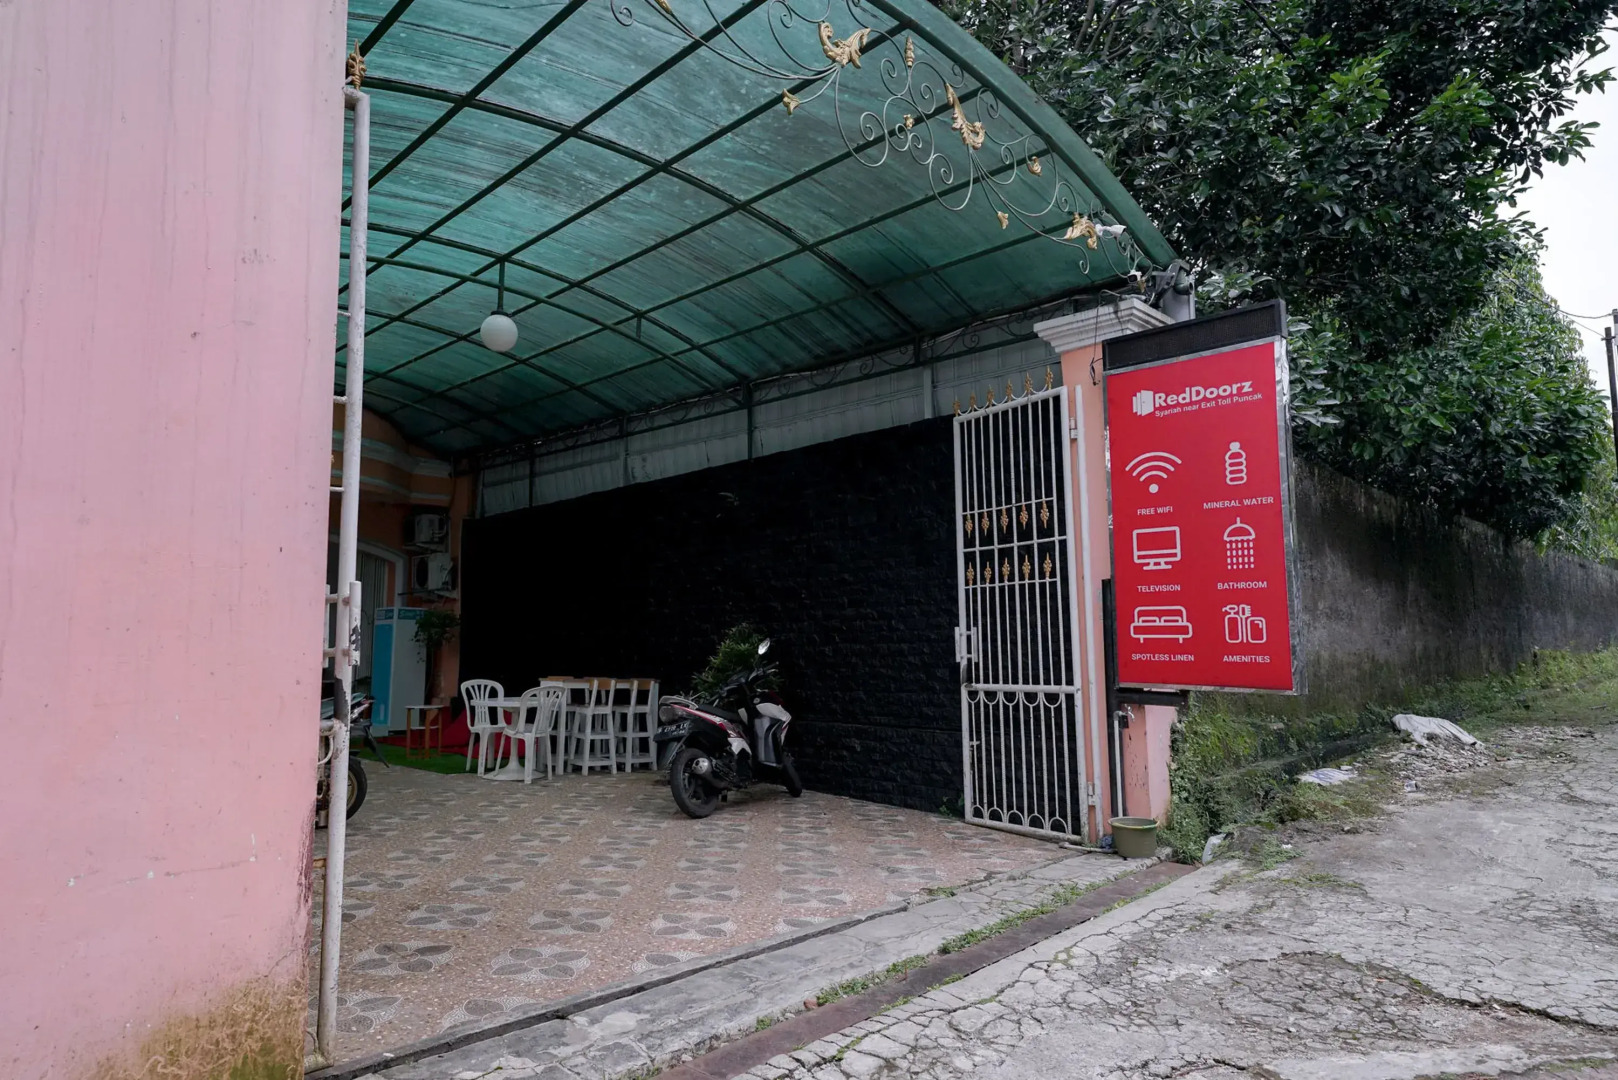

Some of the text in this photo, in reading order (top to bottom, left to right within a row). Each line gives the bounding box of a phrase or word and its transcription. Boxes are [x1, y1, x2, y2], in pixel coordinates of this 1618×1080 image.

[1155, 381, 1253, 407] RedDoorz
[1155, 392, 1263, 417] Syariah near Exit Toll Puncak
[1203, 496, 1275, 509] MINERAL WATER
[1137, 505, 1174, 515] FREE WIFI
[1137, 584, 1181, 593] TELEVISION
[1217, 581, 1268, 590] BATHROOM
[1131, 653, 1195, 662] SPOTLESS LINEN
[1223, 654, 1271, 664] AMENITIES
